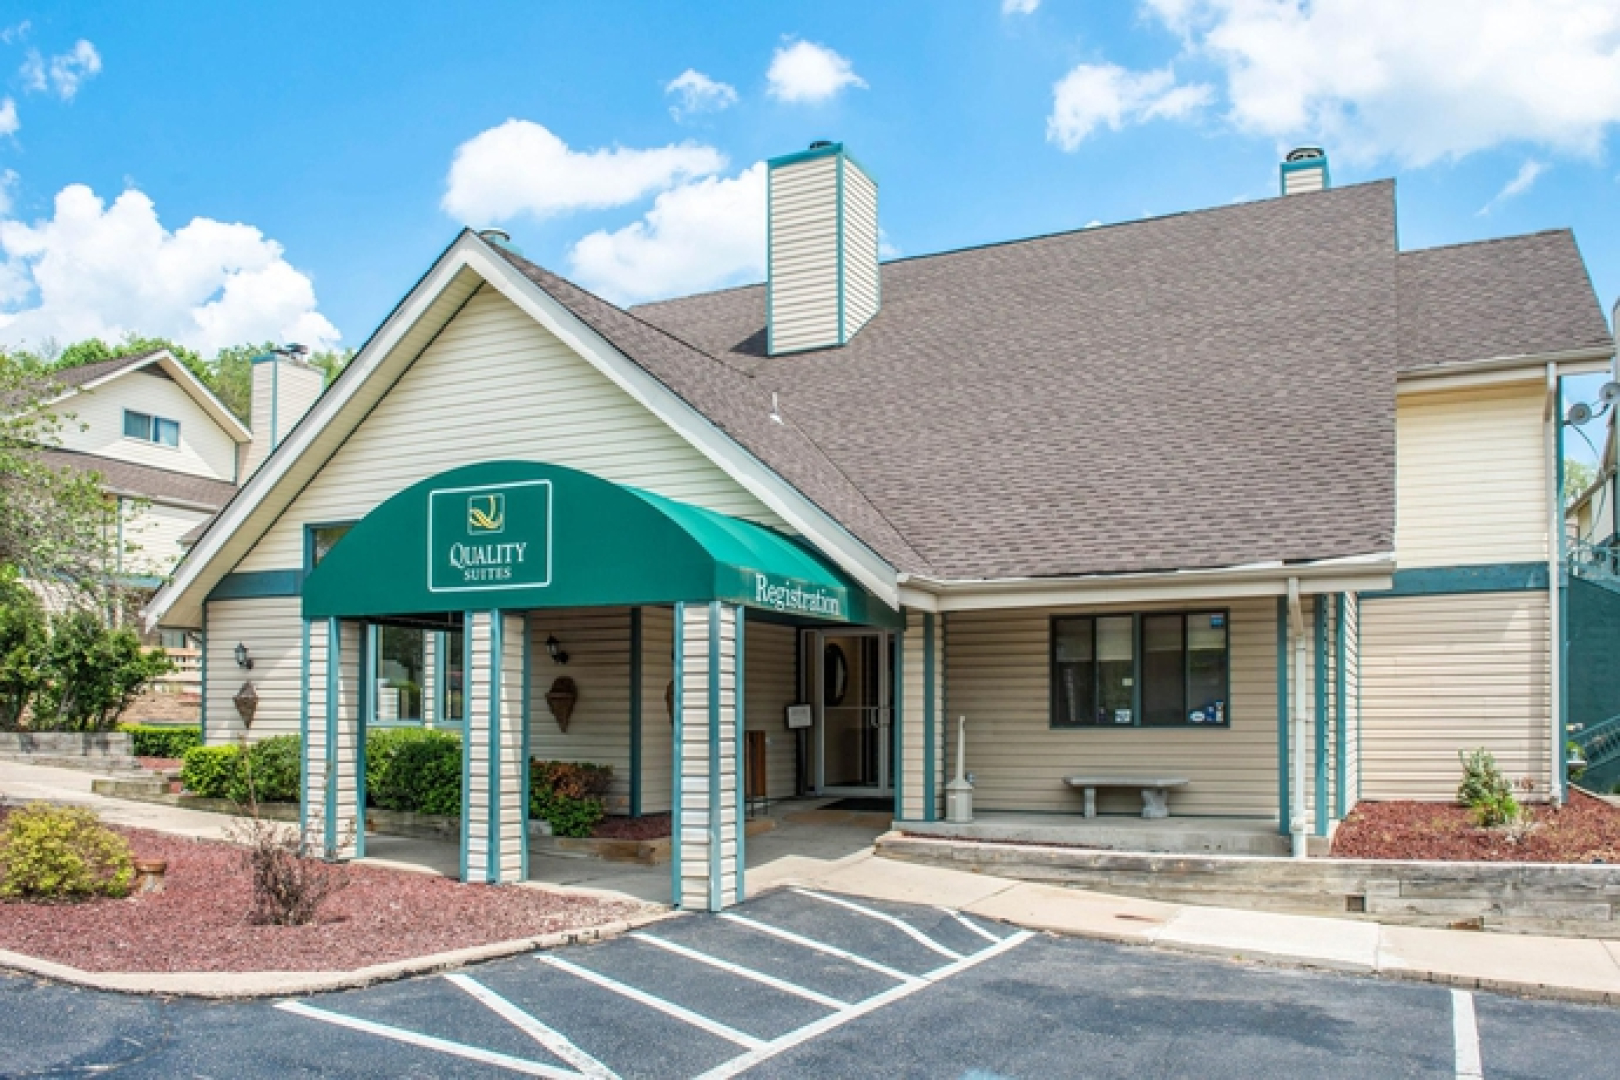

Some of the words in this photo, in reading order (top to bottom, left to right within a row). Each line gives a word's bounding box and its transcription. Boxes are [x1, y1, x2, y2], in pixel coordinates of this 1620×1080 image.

[450, 541, 527, 568] QUALITY
[464, 566, 512, 581] SUITES
[755, 572, 840, 616] Registration
